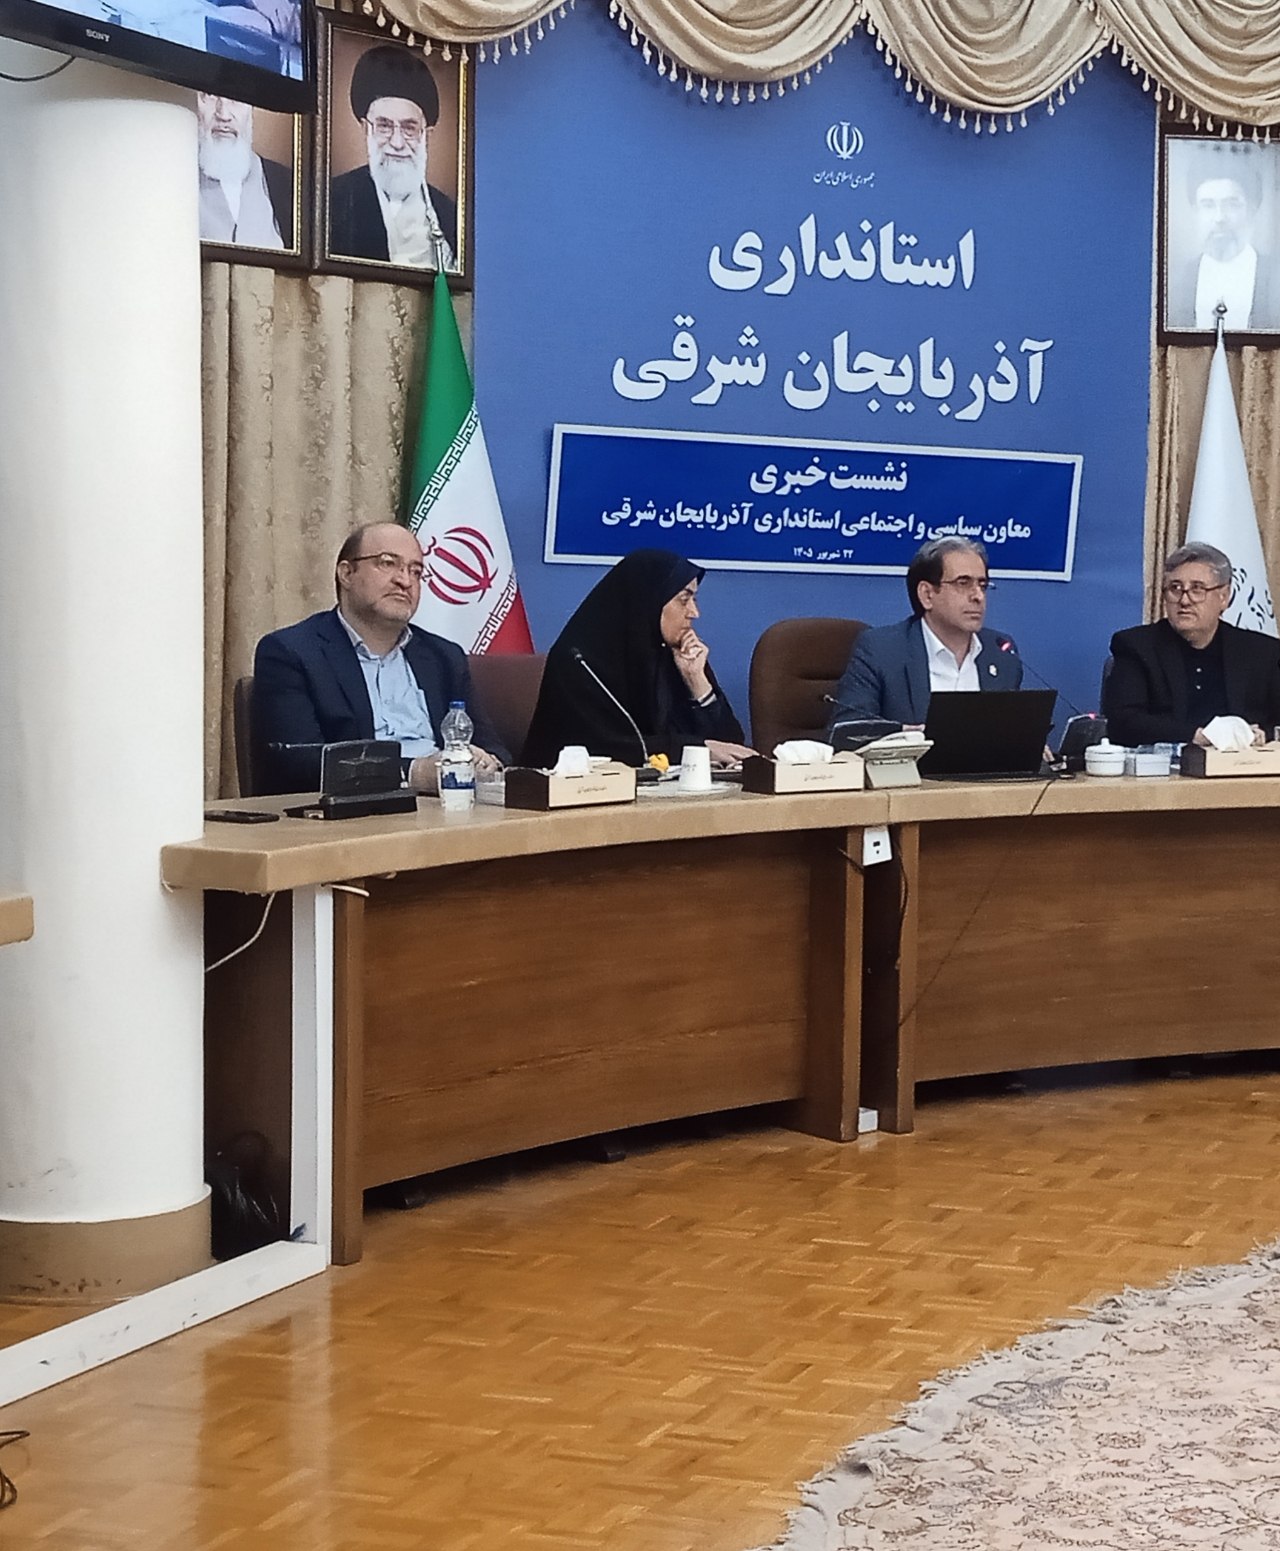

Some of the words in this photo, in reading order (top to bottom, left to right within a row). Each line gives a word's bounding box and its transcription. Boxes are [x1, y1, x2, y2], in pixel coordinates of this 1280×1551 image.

[85, 28, 111, 42] SONY
[707, 213, 975, 296] استانداری
[611, 314, 767, 405] شرقی
[782, 329, 1055, 421] آذربایجان
[749, 456, 827, 496] خبری
[829, 461, 908, 492] نشست
[601, 497, 657, 528] شرقی
[658, 502, 754, 531] آذربایجان
[753, 507, 841, 534] استانداری
[841, 511, 915, 539] اجتماعی
[913, 521, 926, 540] و
[926, 515, 982, 541] سیاسی
[982, 517, 1032, 544] معاون
